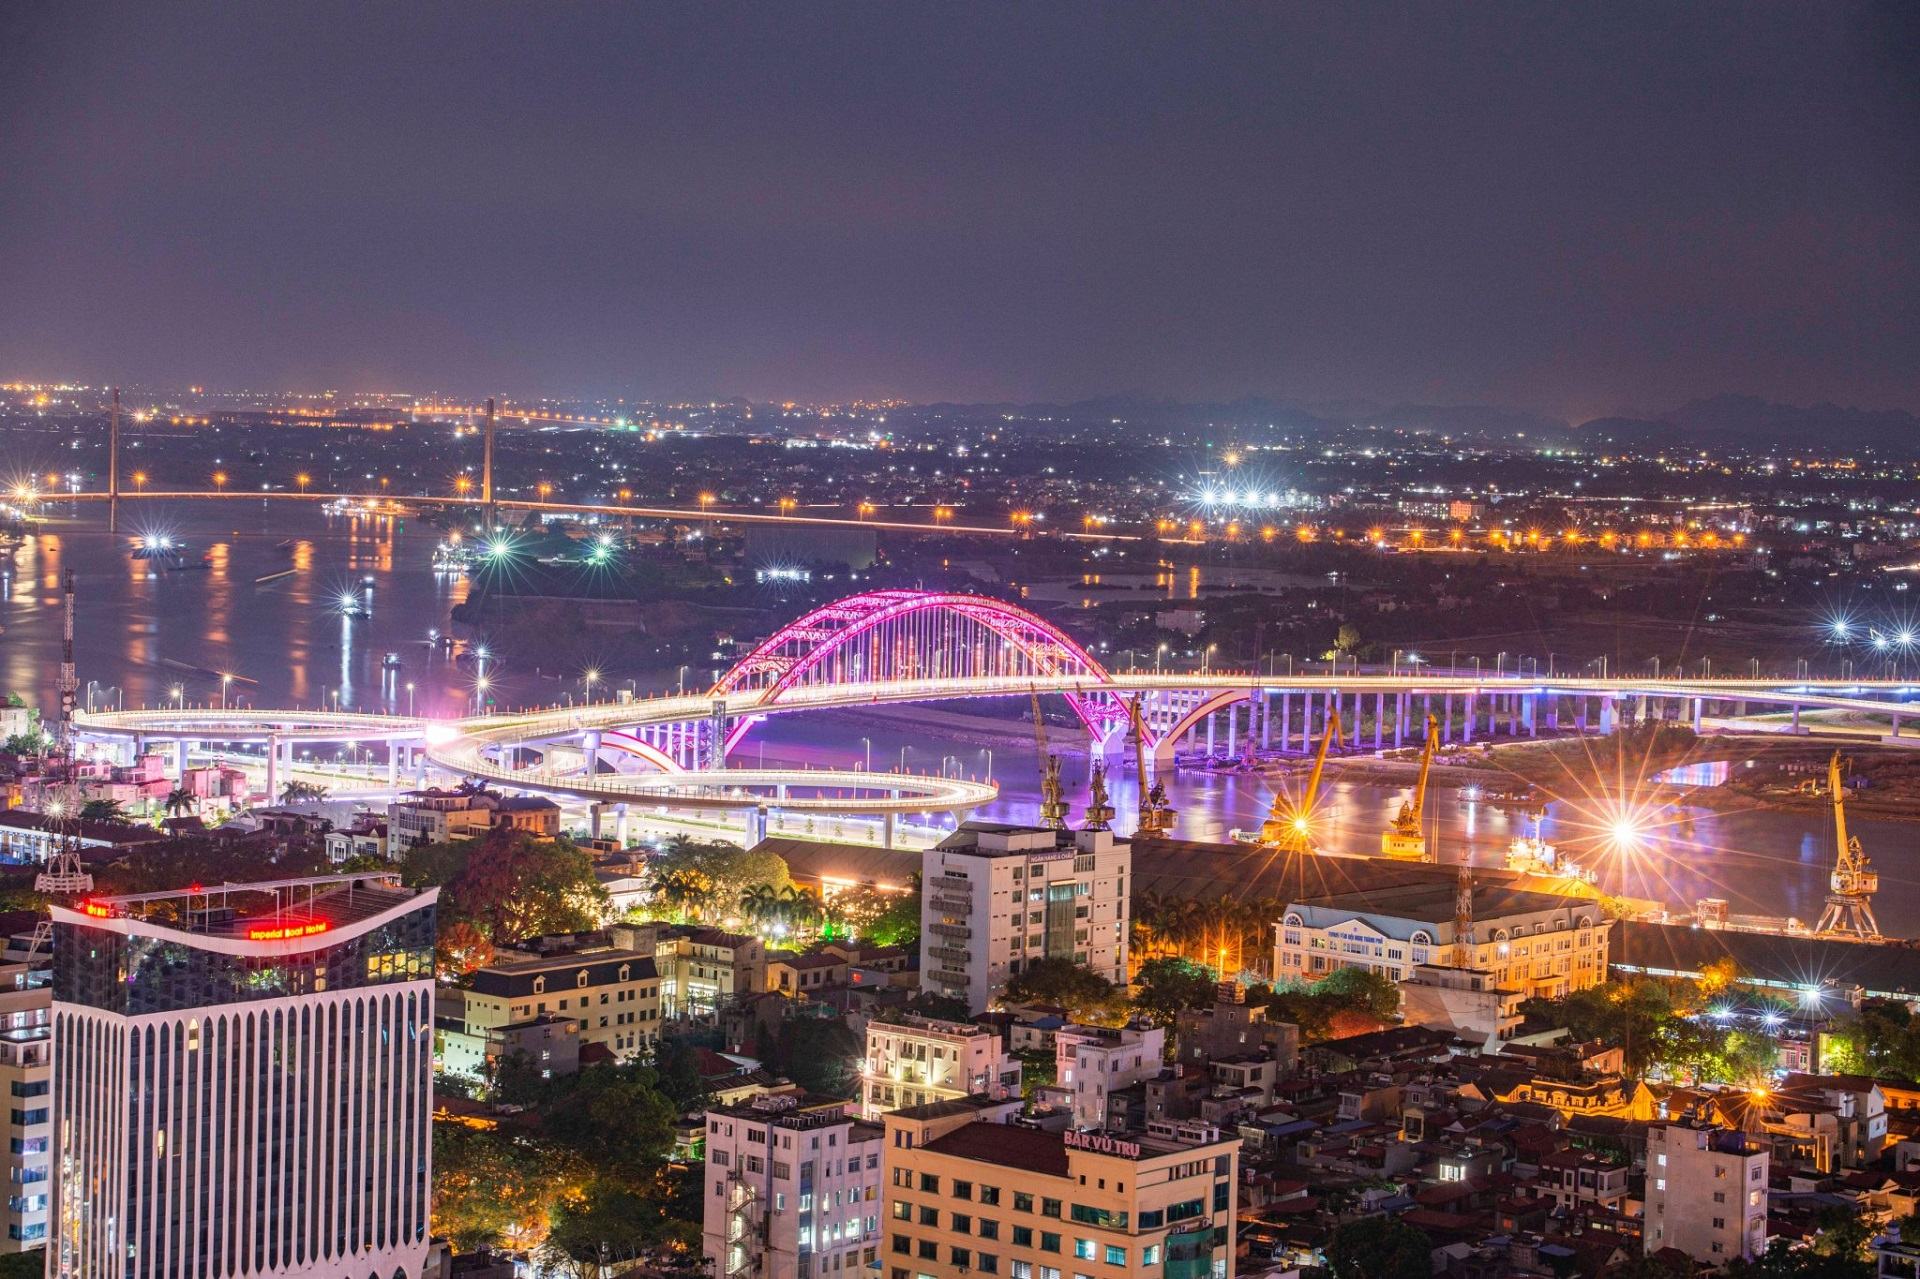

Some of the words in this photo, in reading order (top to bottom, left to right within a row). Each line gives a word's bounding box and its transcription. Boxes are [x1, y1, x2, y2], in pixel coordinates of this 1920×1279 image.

[250, 929, 283, 941] Imperial
[305, 922, 327, 934] Hotel
[1064, 1131, 1090, 1148] BAR
